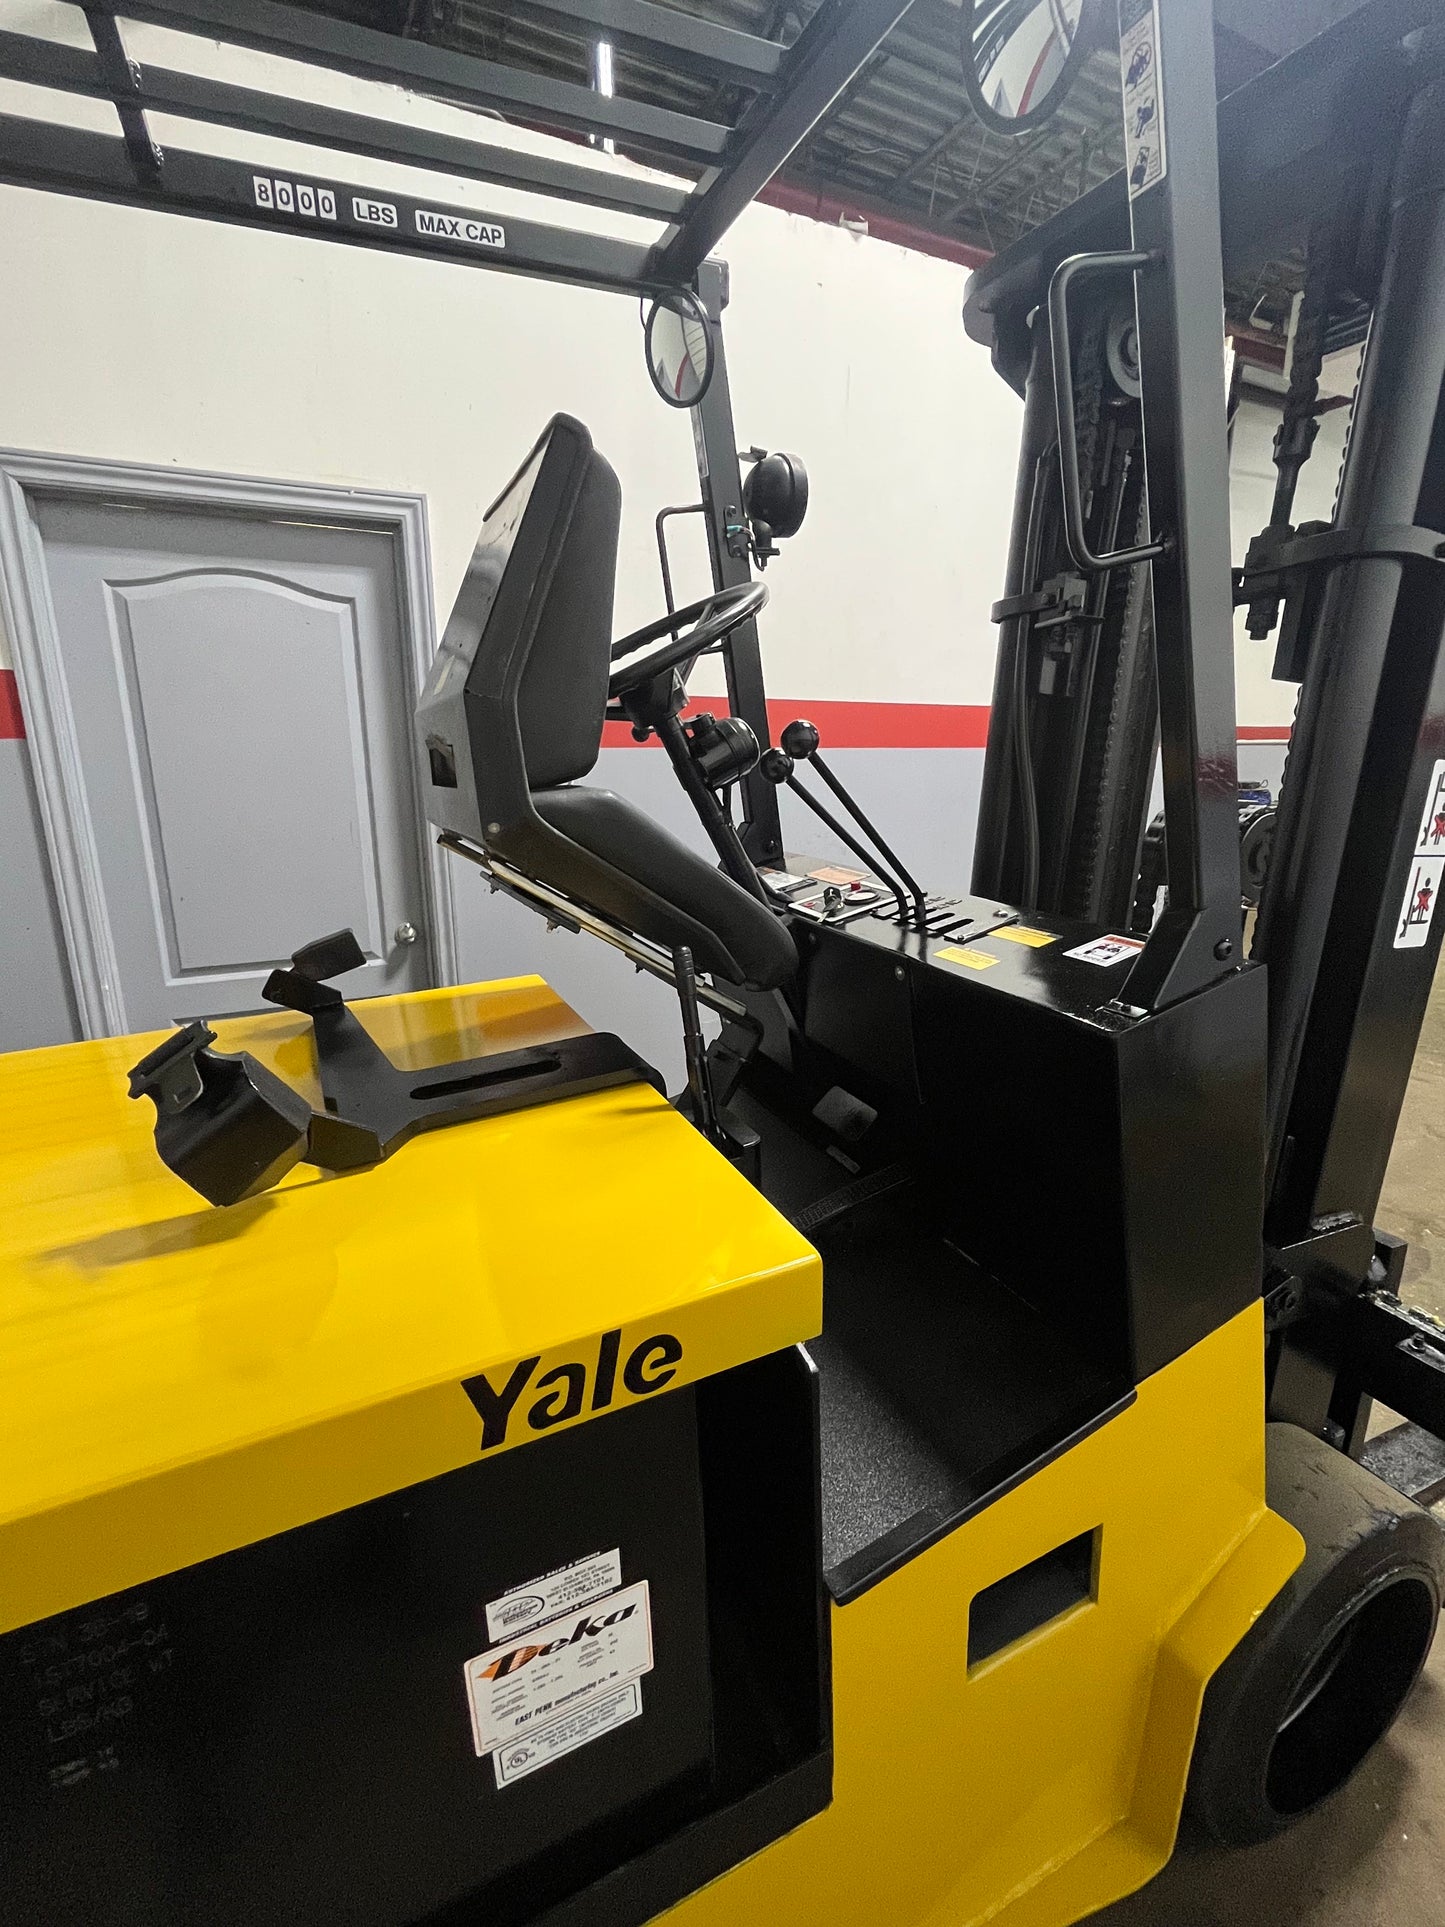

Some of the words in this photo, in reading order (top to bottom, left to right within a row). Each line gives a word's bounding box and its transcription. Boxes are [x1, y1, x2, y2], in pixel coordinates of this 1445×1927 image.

[257, 183, 333, 214] 8000
[355, 200, 394, 225] LBS
[419, 213, 461, 238] MAX
[465, 223, 502, 245] CAP
[460, 1328, 683, 1451] Yale
[488, 1603, 637, 1682] Deka
[514, 1710, 532, 1726] EAST
